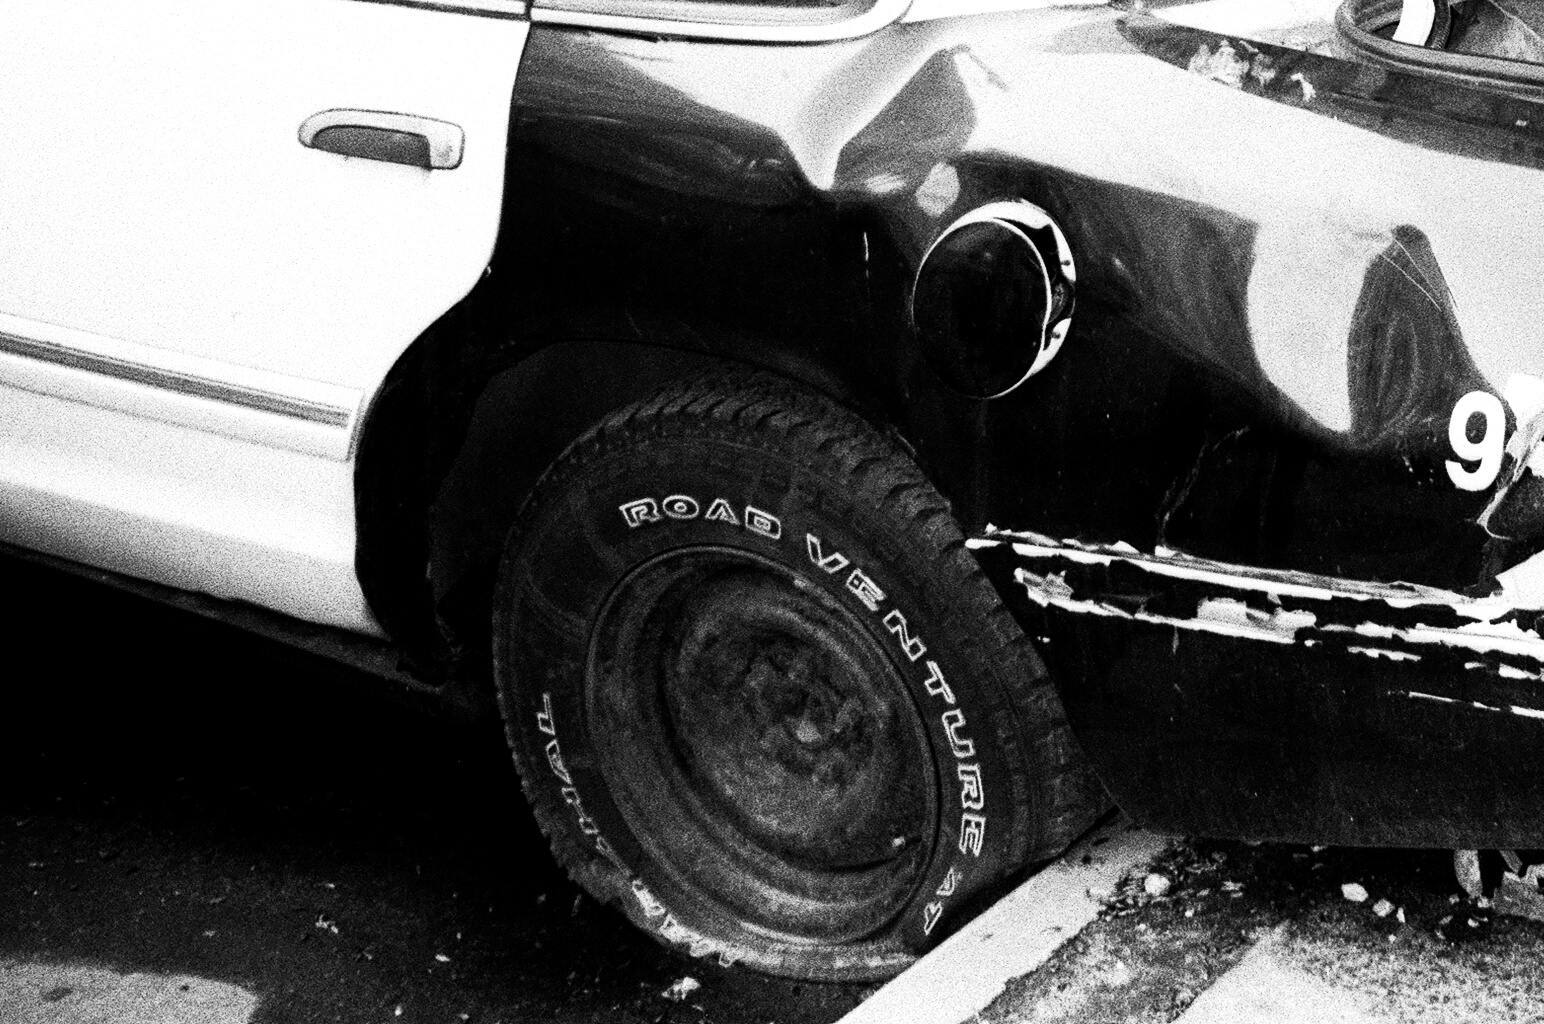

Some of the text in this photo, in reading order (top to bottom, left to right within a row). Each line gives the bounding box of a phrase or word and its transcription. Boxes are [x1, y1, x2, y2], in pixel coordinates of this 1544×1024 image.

[1446, 390, 1506, 492] 9
[619, 495, 986, 936] ROAD VENTURE AT
